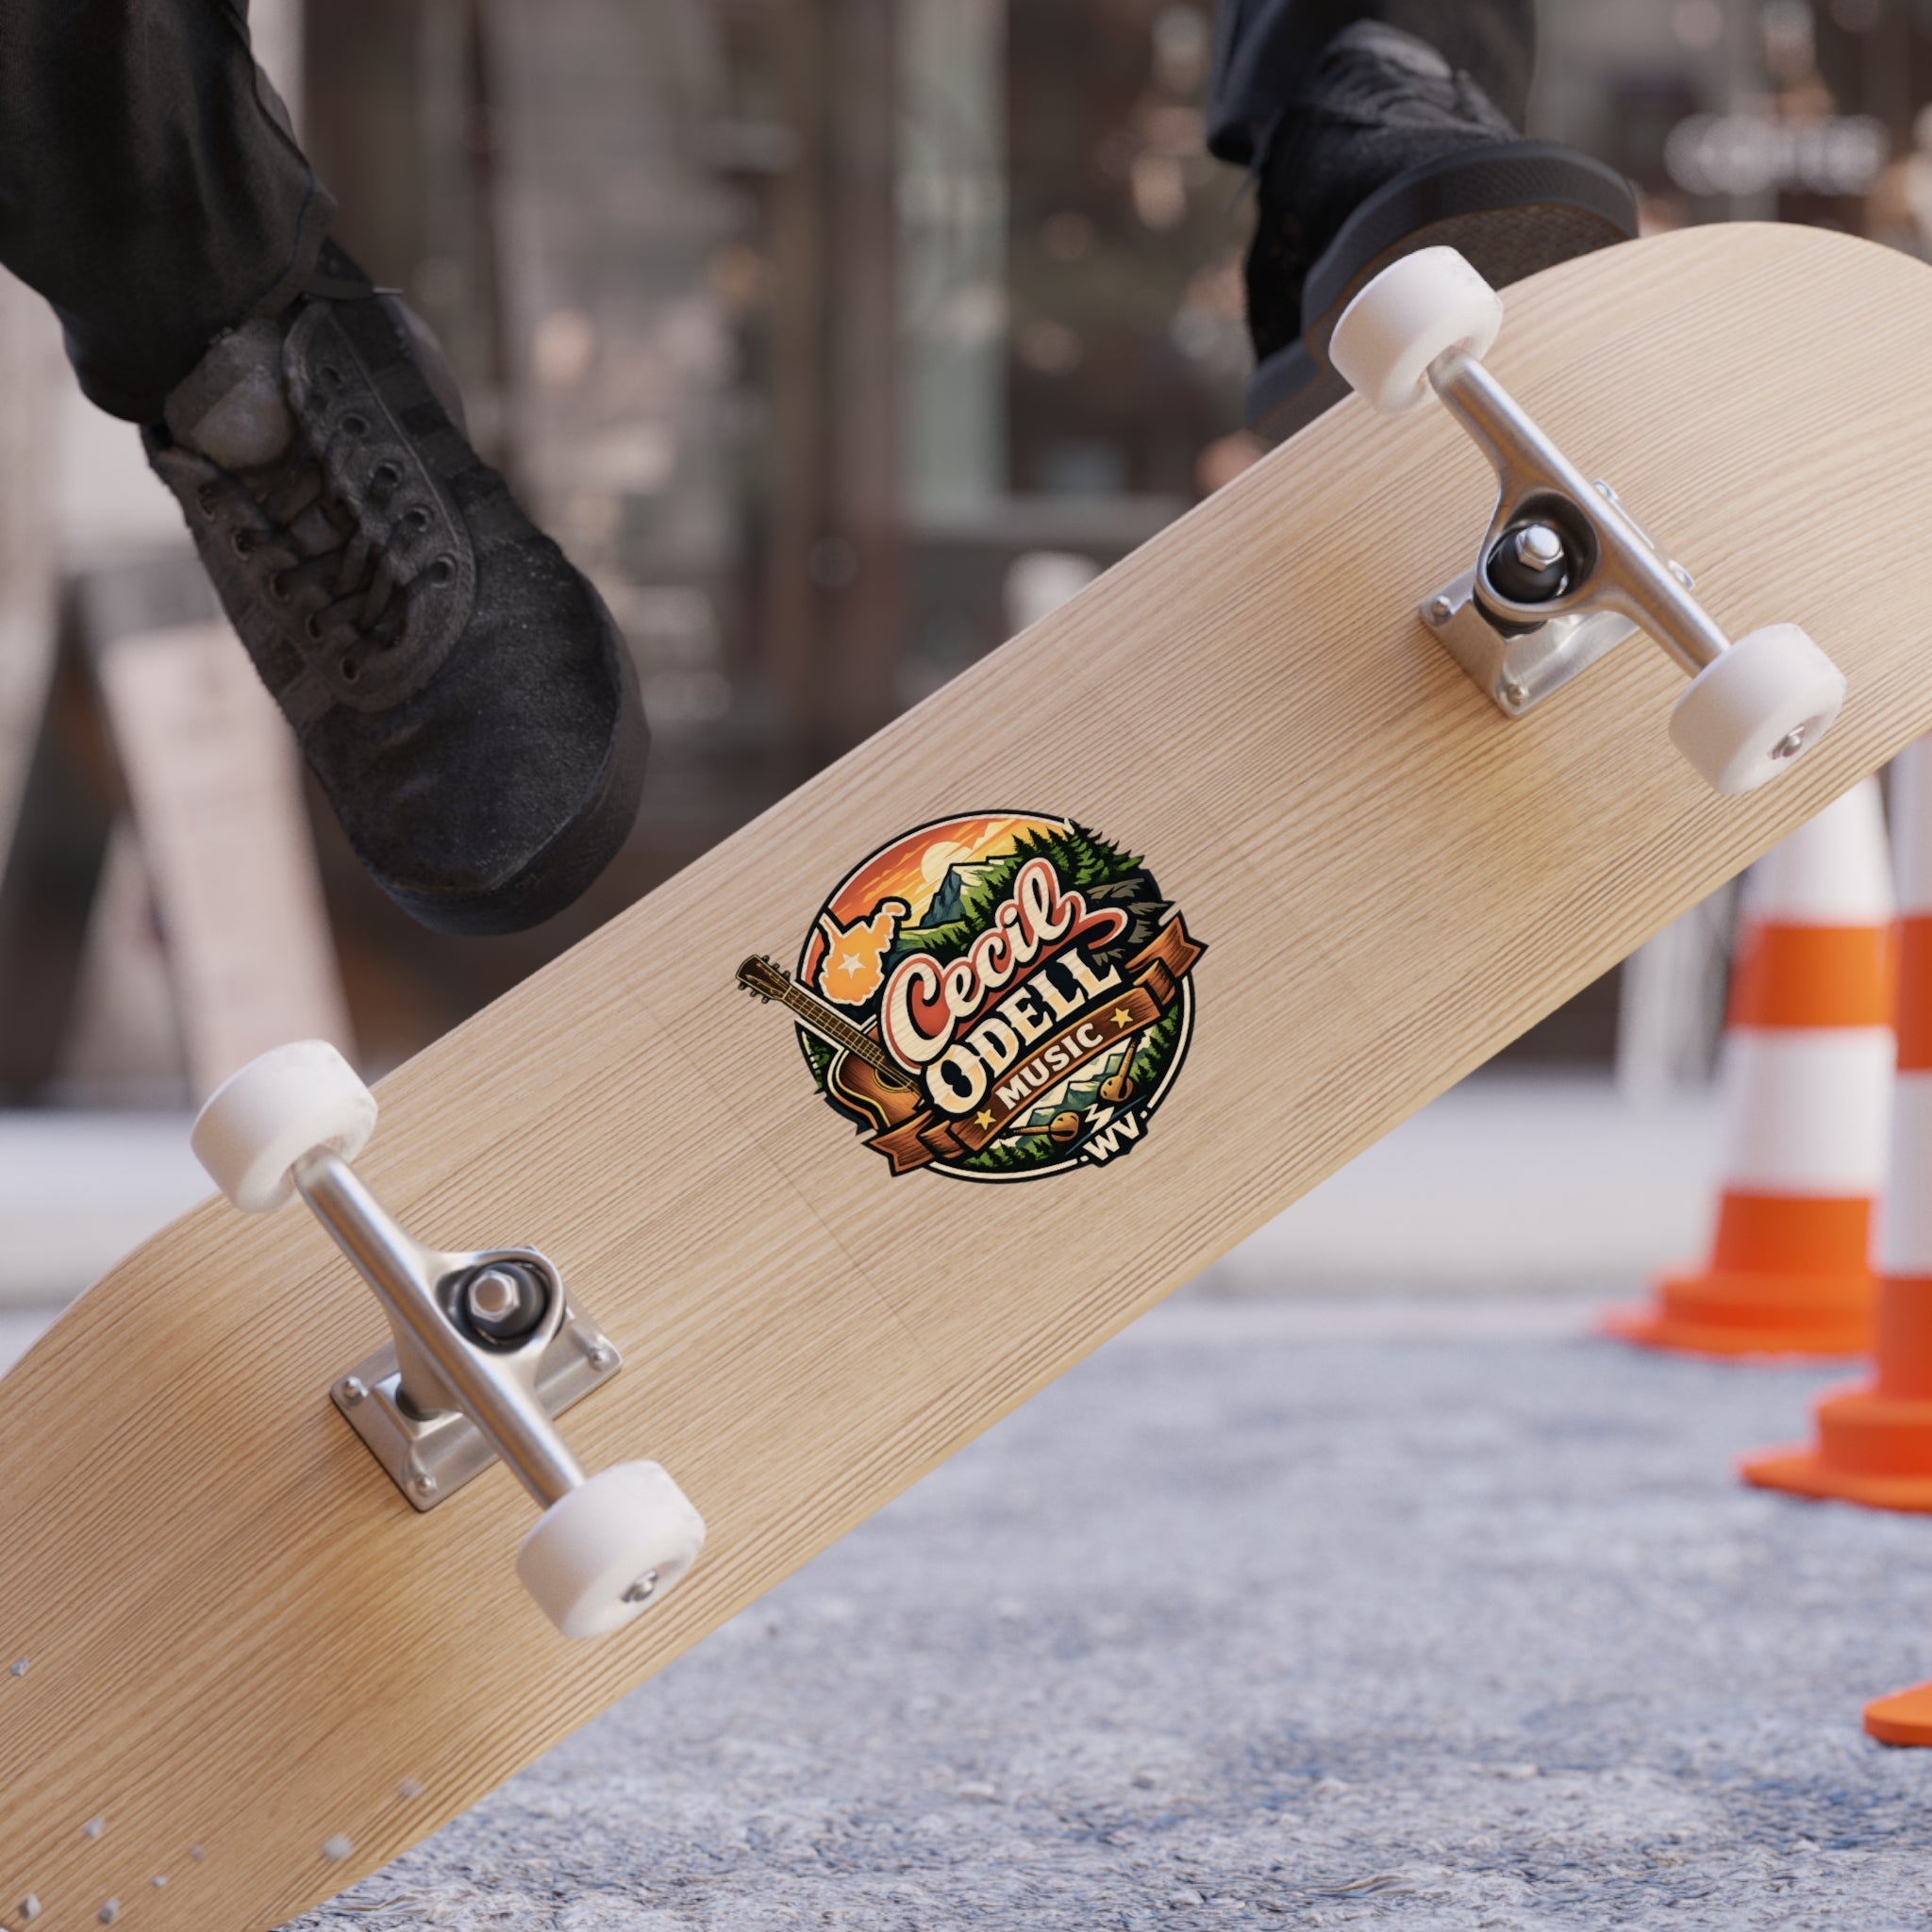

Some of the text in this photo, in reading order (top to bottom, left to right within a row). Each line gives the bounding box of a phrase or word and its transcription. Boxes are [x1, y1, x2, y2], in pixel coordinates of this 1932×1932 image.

[881, 857, 1128, 1075] Cecil
[925, 947, 1123, 1114] ODELL
[994, 1022, 1104, 1111] MUSIC
